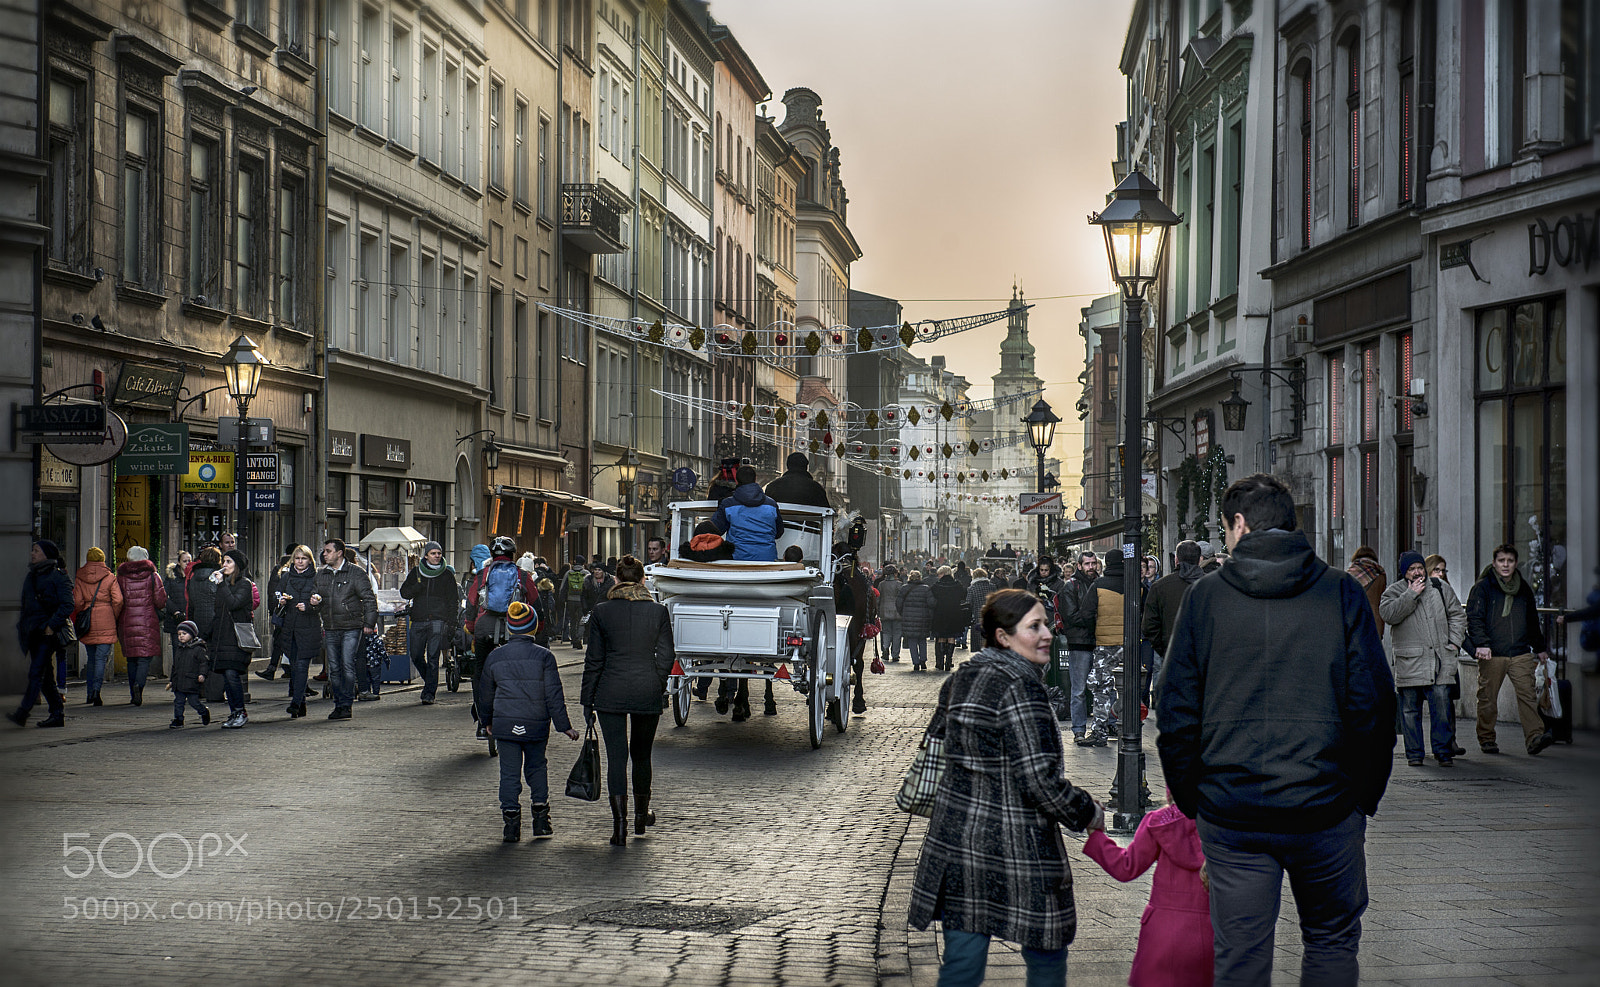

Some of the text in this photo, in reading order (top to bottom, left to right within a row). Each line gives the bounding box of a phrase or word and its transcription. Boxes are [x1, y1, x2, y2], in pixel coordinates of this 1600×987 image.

[125, 375, 144, 392] Café
[84, 407, 98, 423] 13
[138, 434, 165, 443] Café
[130, 460, 175, 470] wine bar
[116, 487, 140, 498] INE
[255, 492, 275, 500] Local
[116, 501, 135, 511] AR
